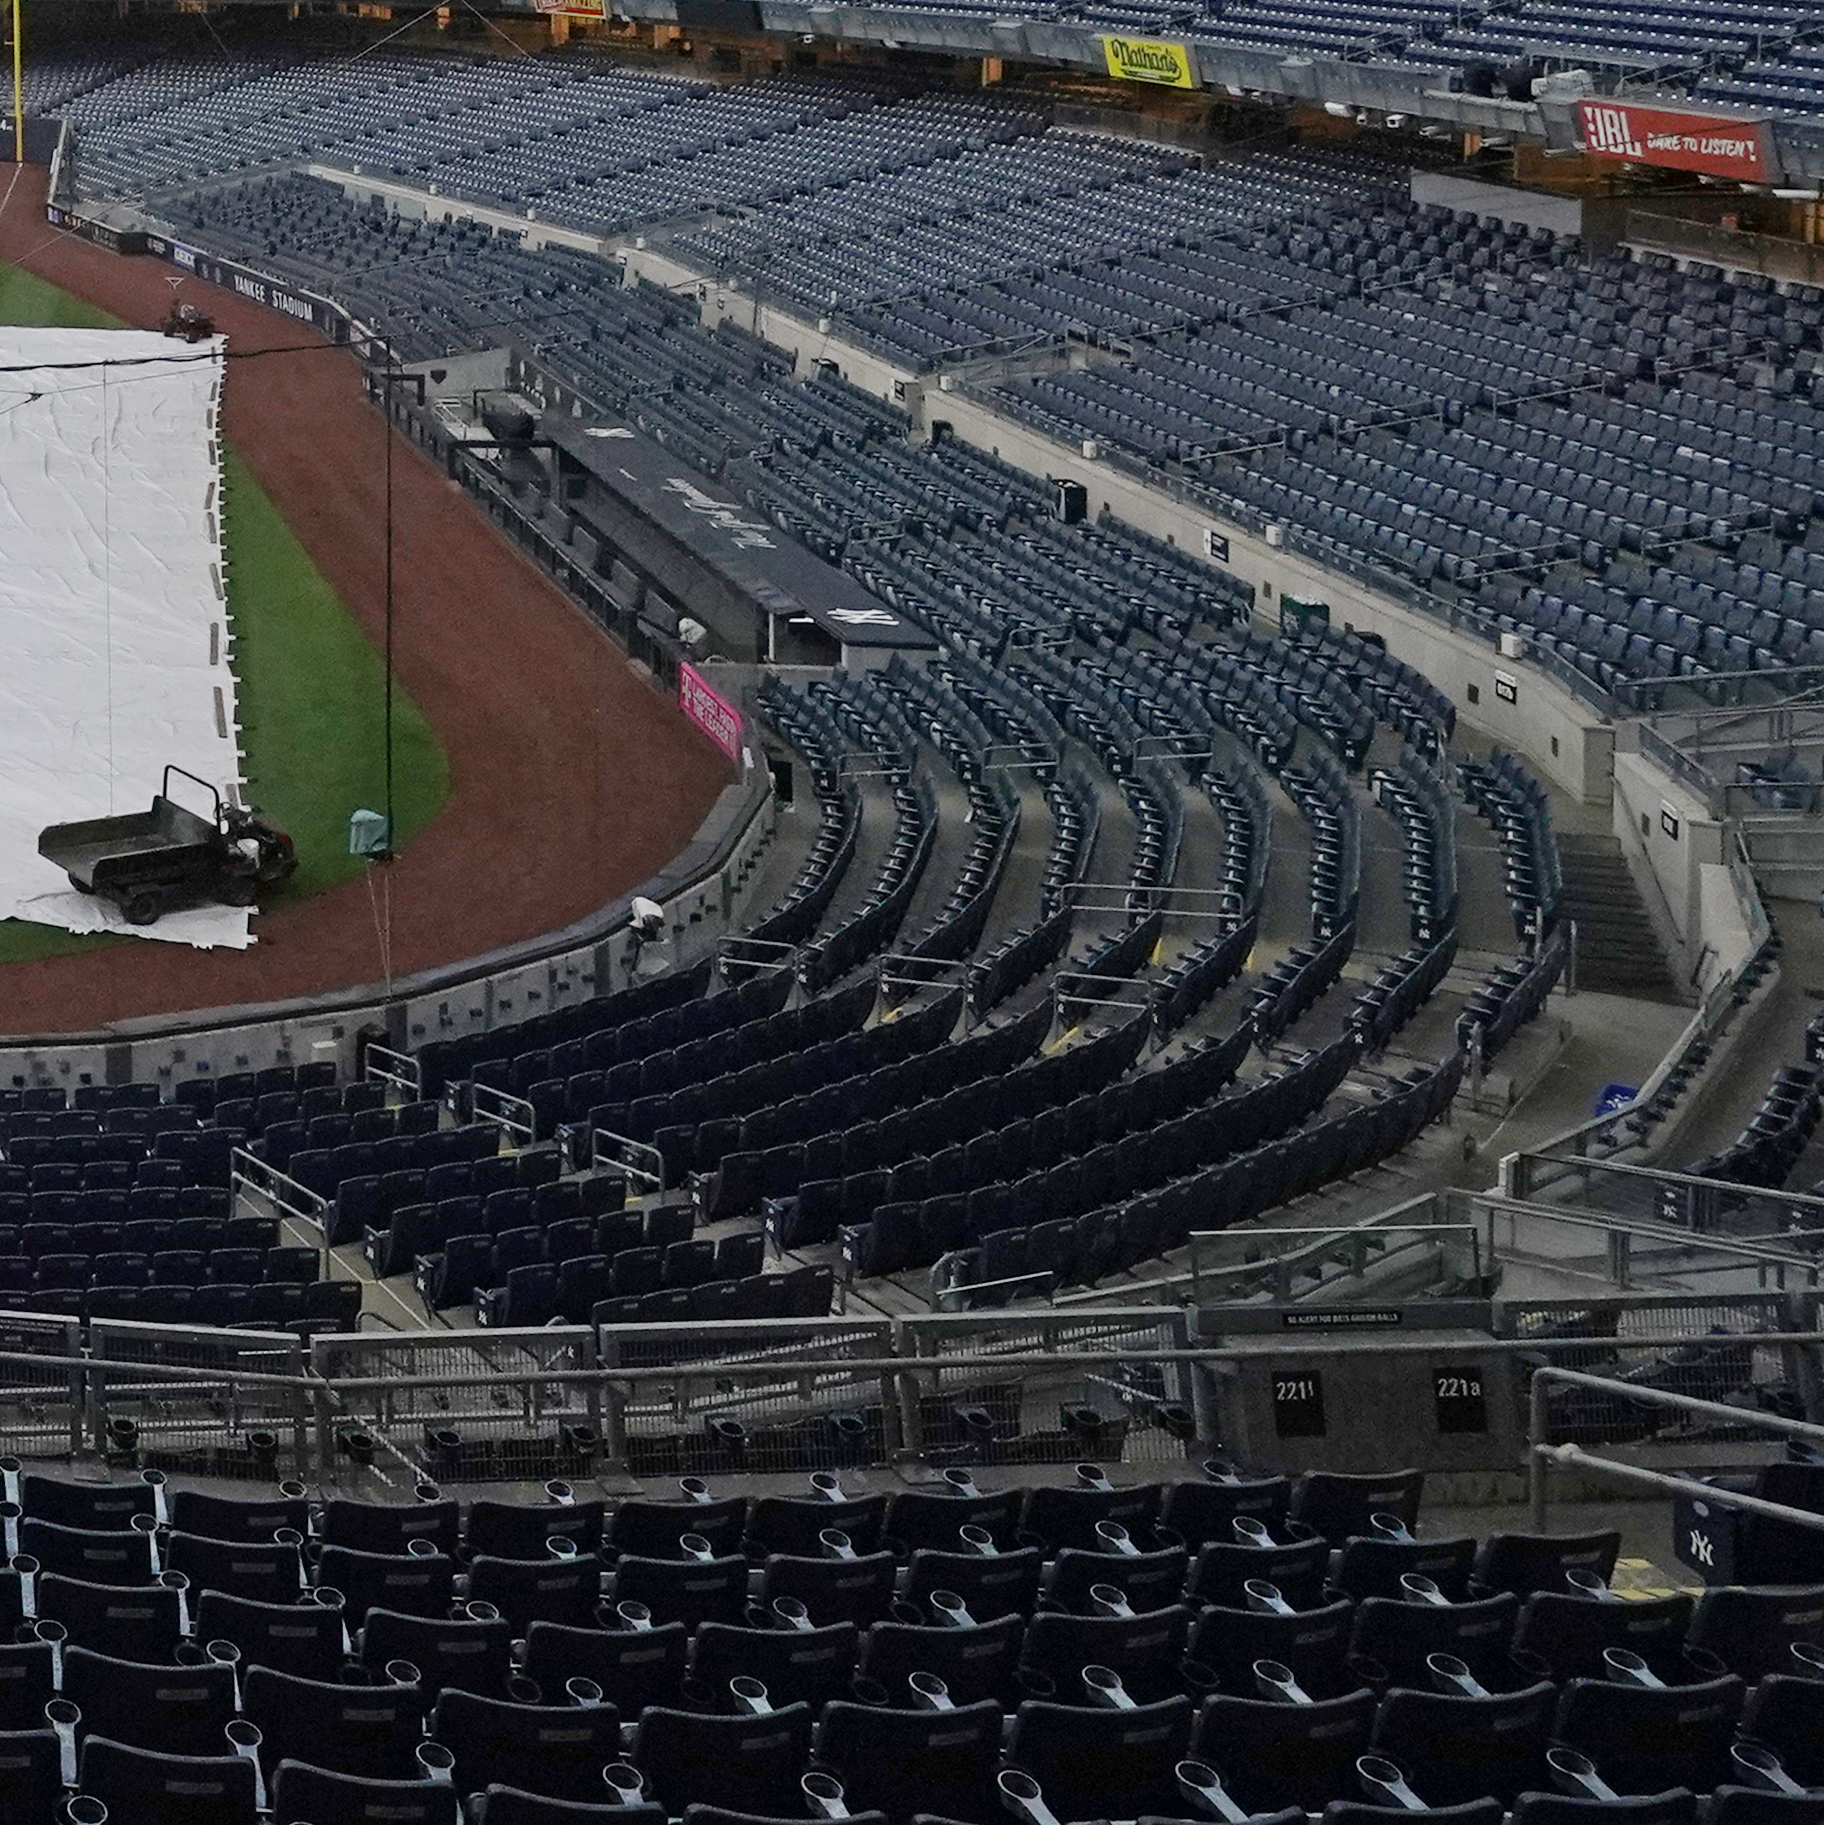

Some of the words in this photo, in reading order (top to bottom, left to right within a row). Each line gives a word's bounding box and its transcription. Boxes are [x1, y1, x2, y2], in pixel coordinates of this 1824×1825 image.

[1683, 137, 1697, 151] TO
[234, 274, 266, 303] YANKEE
[271, 289, 313, 322] STADIUM
[1437, 1377, 1482, 1398] 221a
